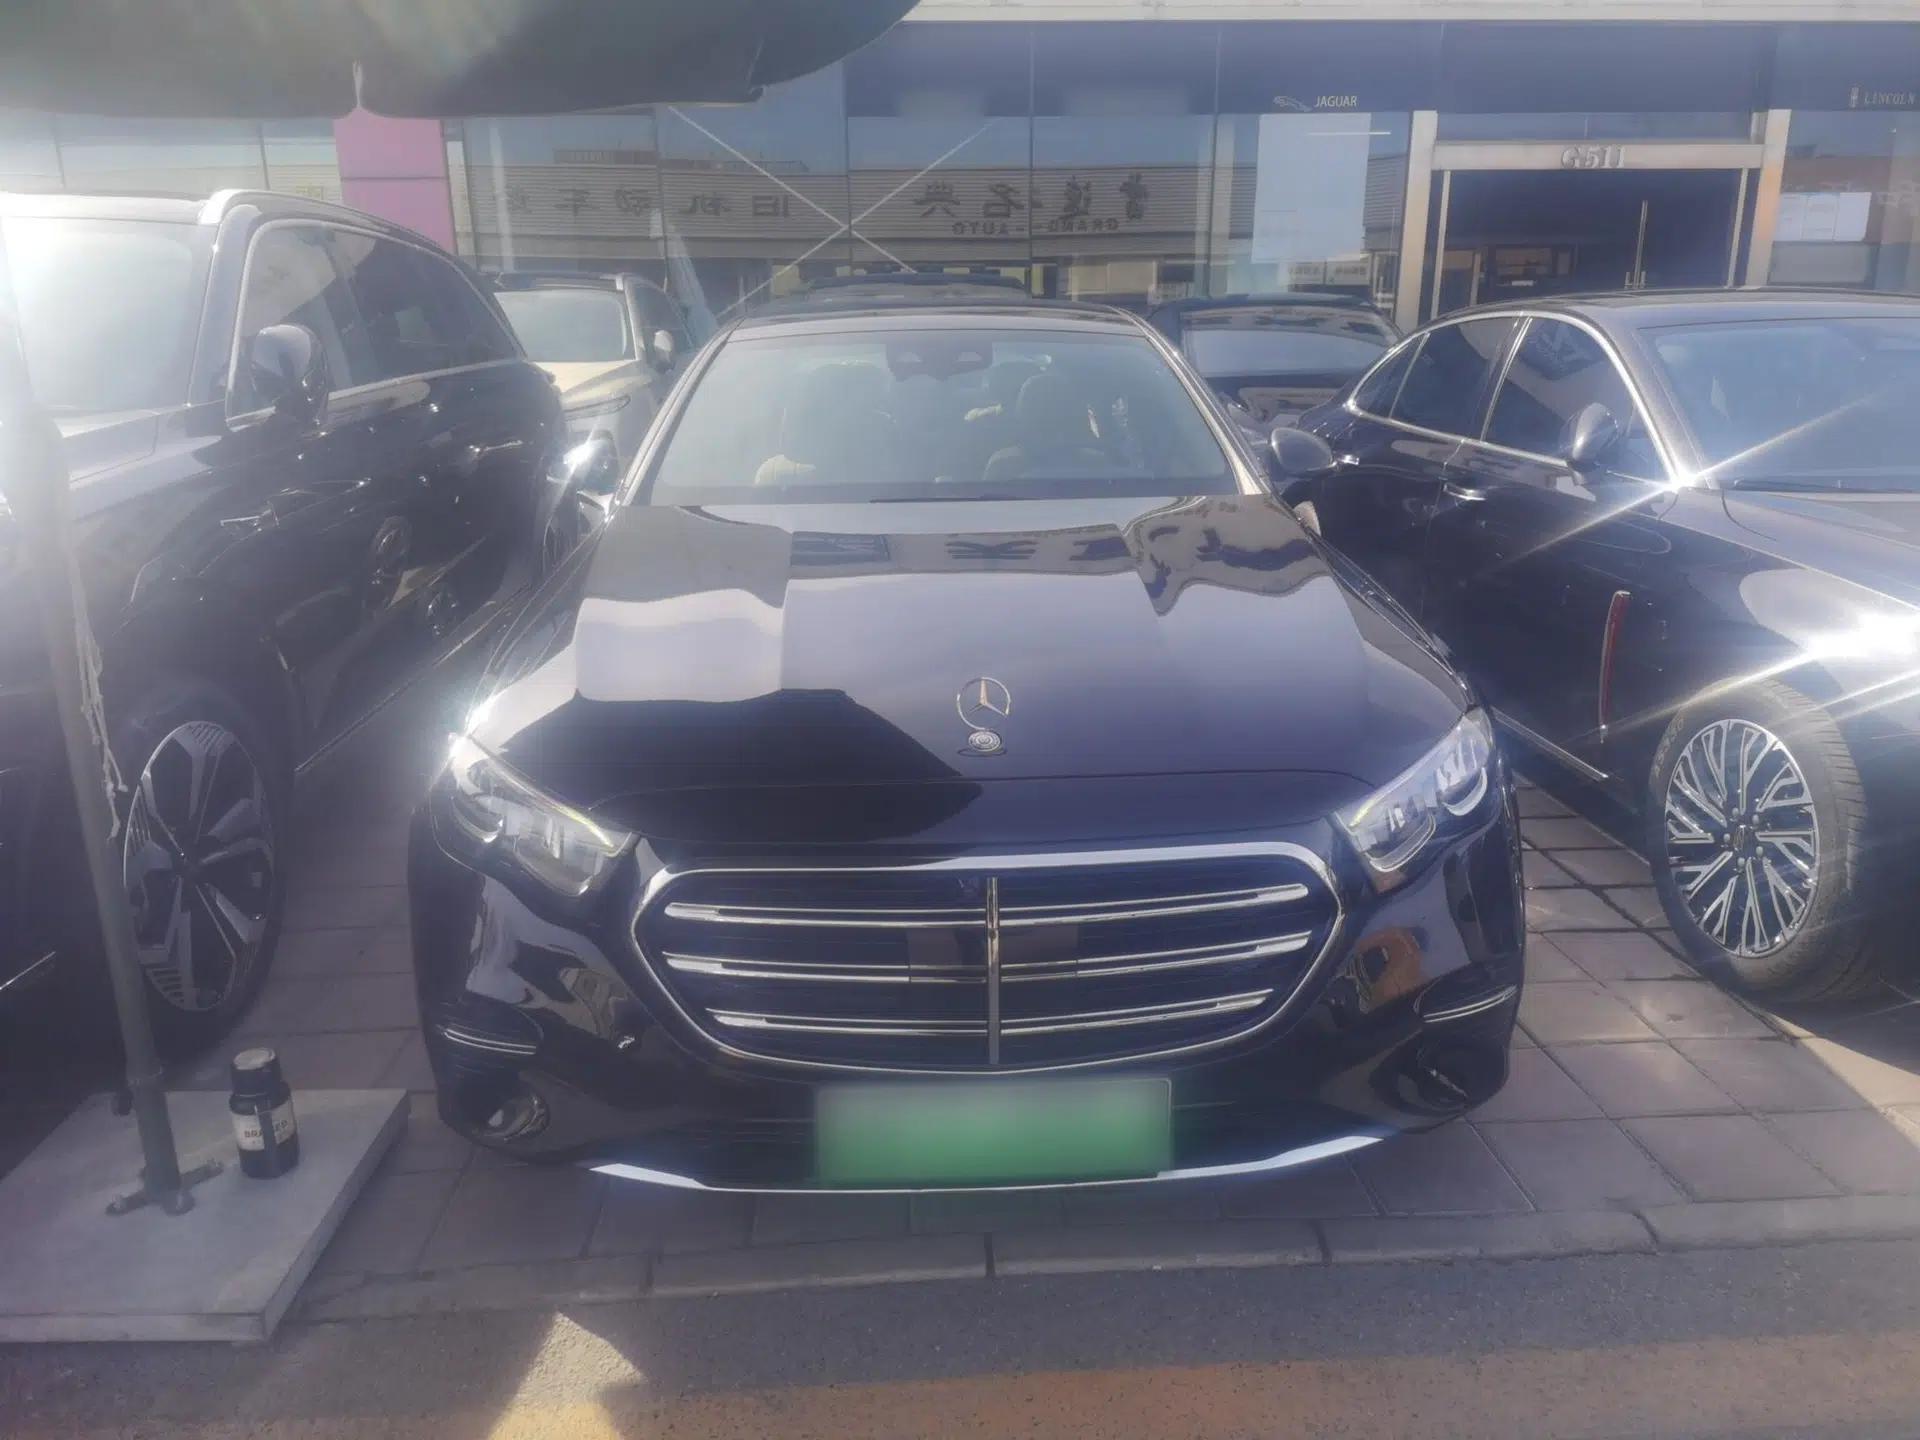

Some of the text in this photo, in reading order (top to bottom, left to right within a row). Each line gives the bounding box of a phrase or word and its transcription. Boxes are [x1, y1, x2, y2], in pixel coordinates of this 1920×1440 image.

[1313, 95, 1358, 108] JAGUAR
[1863, 91, 1916, 105] LINCOLN
[1561, 146, 1625, 169] G511
